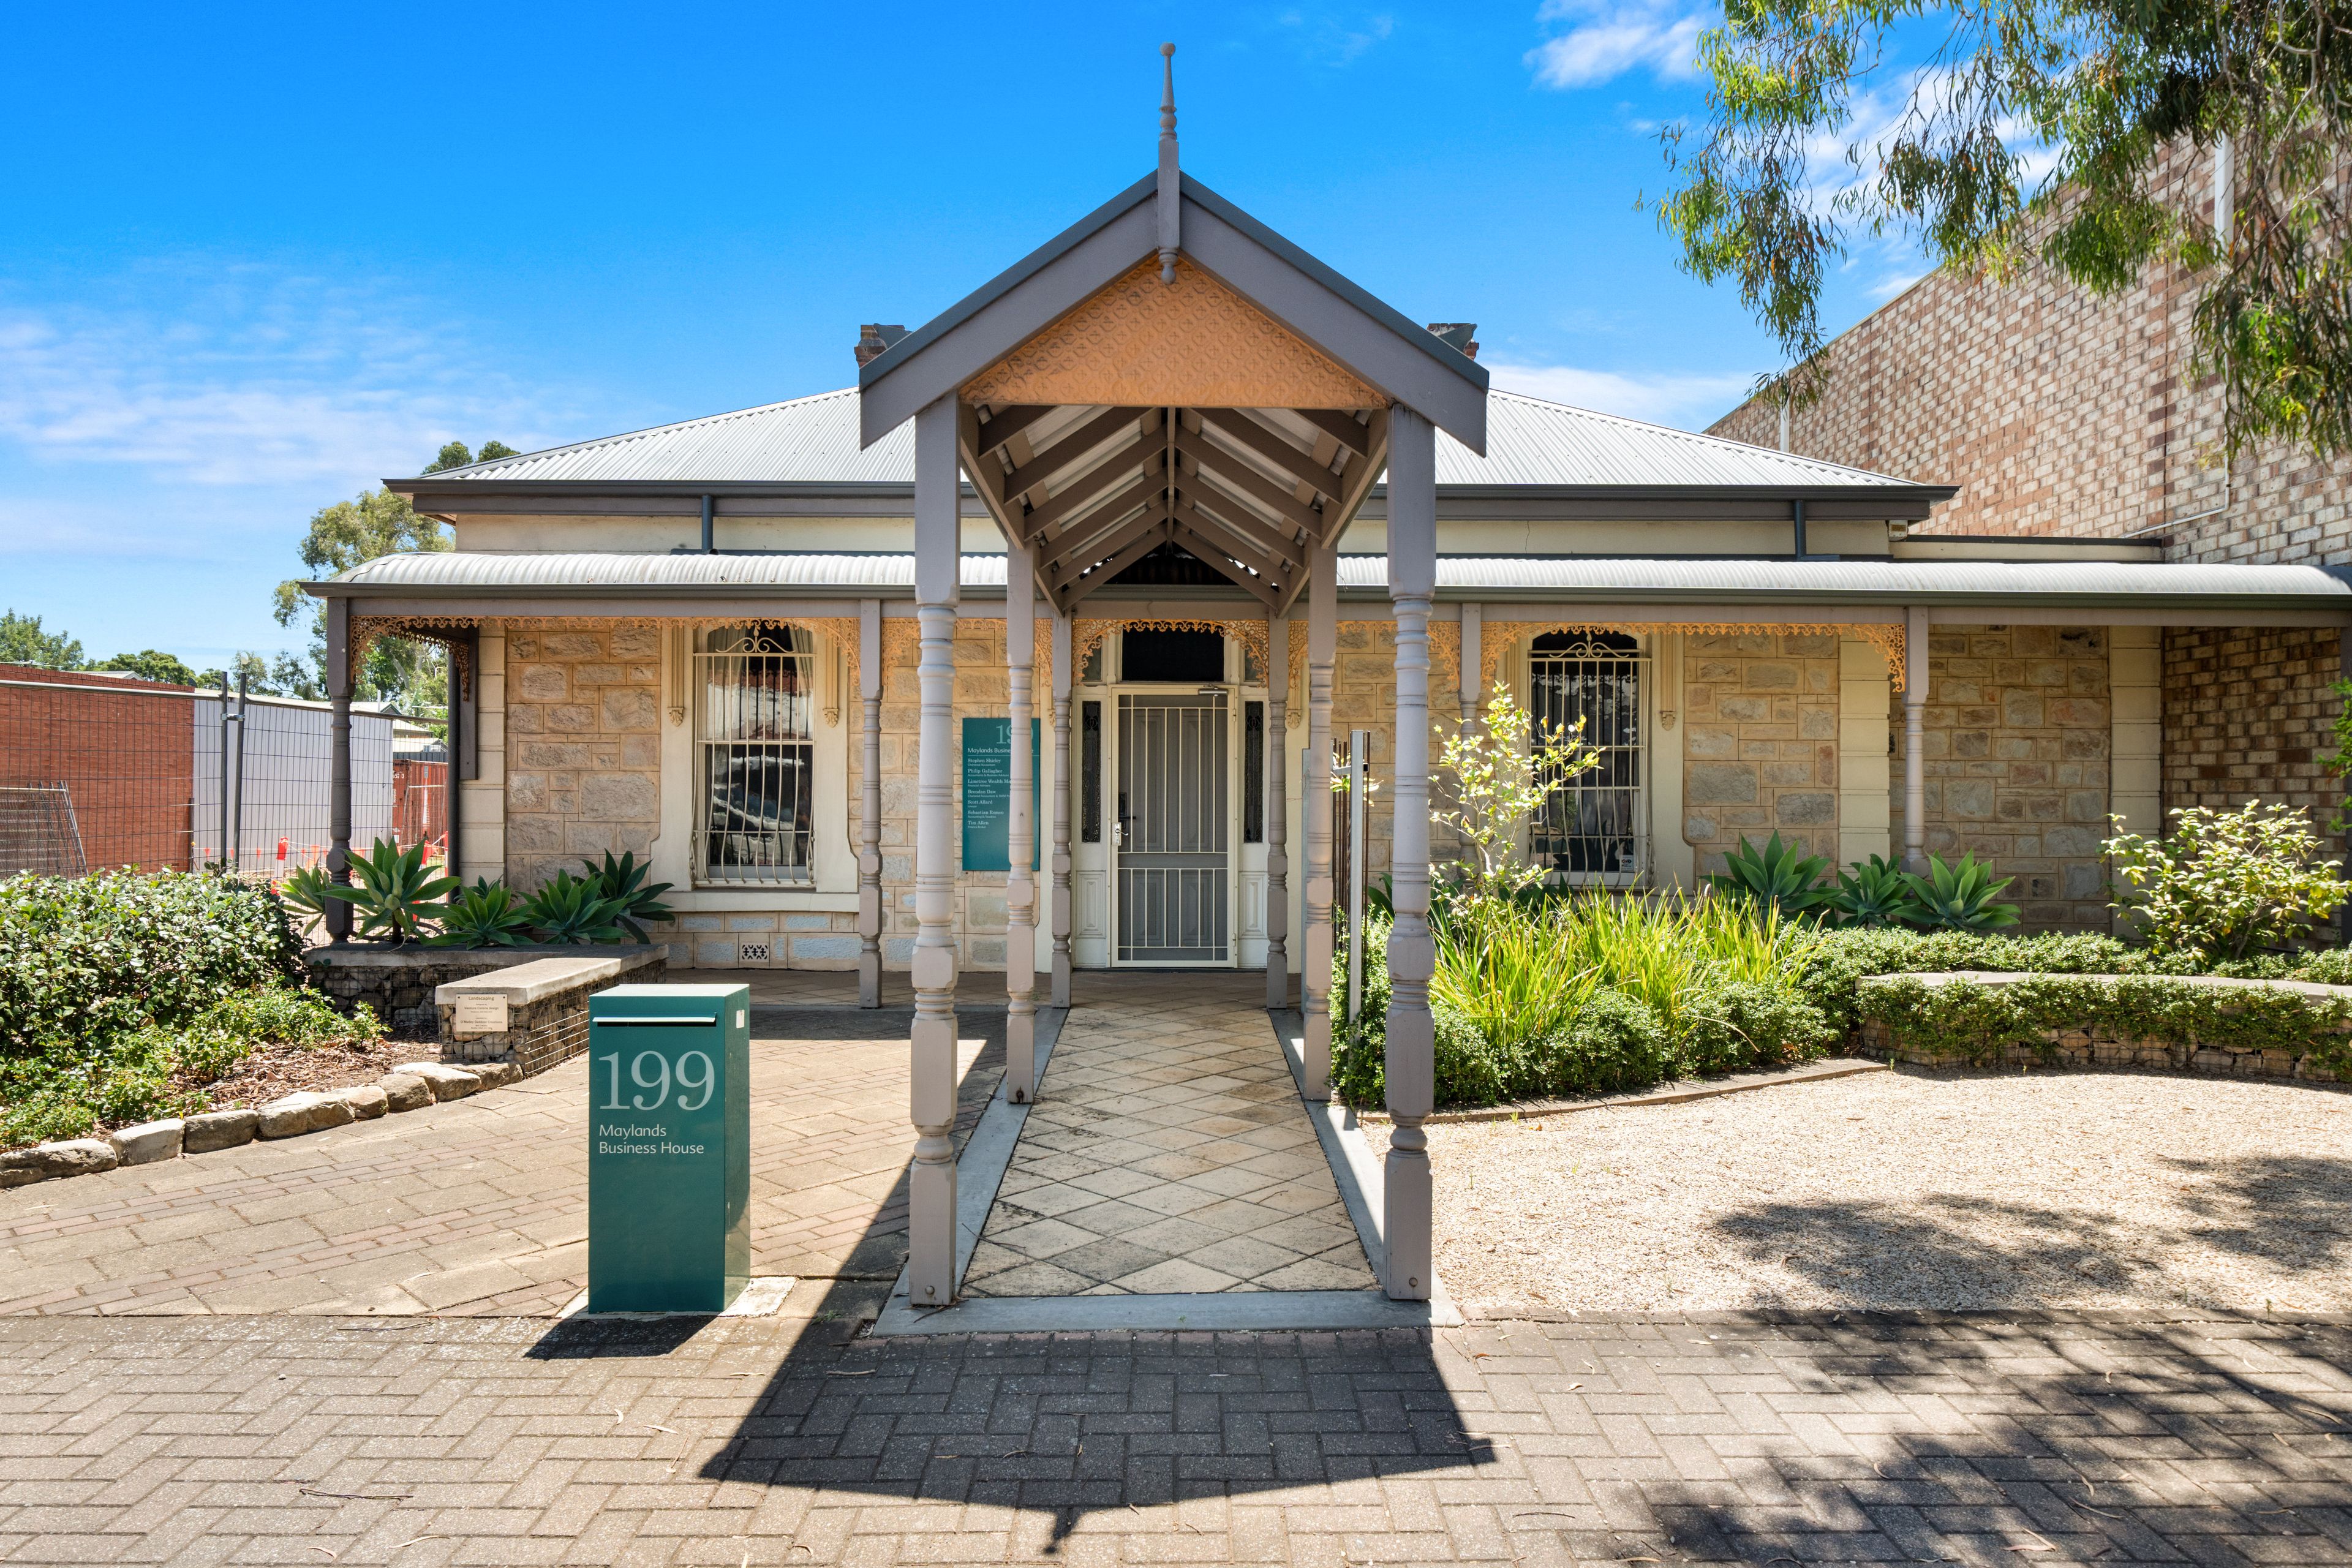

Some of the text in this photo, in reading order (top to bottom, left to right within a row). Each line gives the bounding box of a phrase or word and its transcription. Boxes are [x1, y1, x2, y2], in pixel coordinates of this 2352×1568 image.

[598, 1050, 715, 1110] 199
[599, 1124, 666, 1140] Maylands
[599, 1142, 704, 1154] Business House
